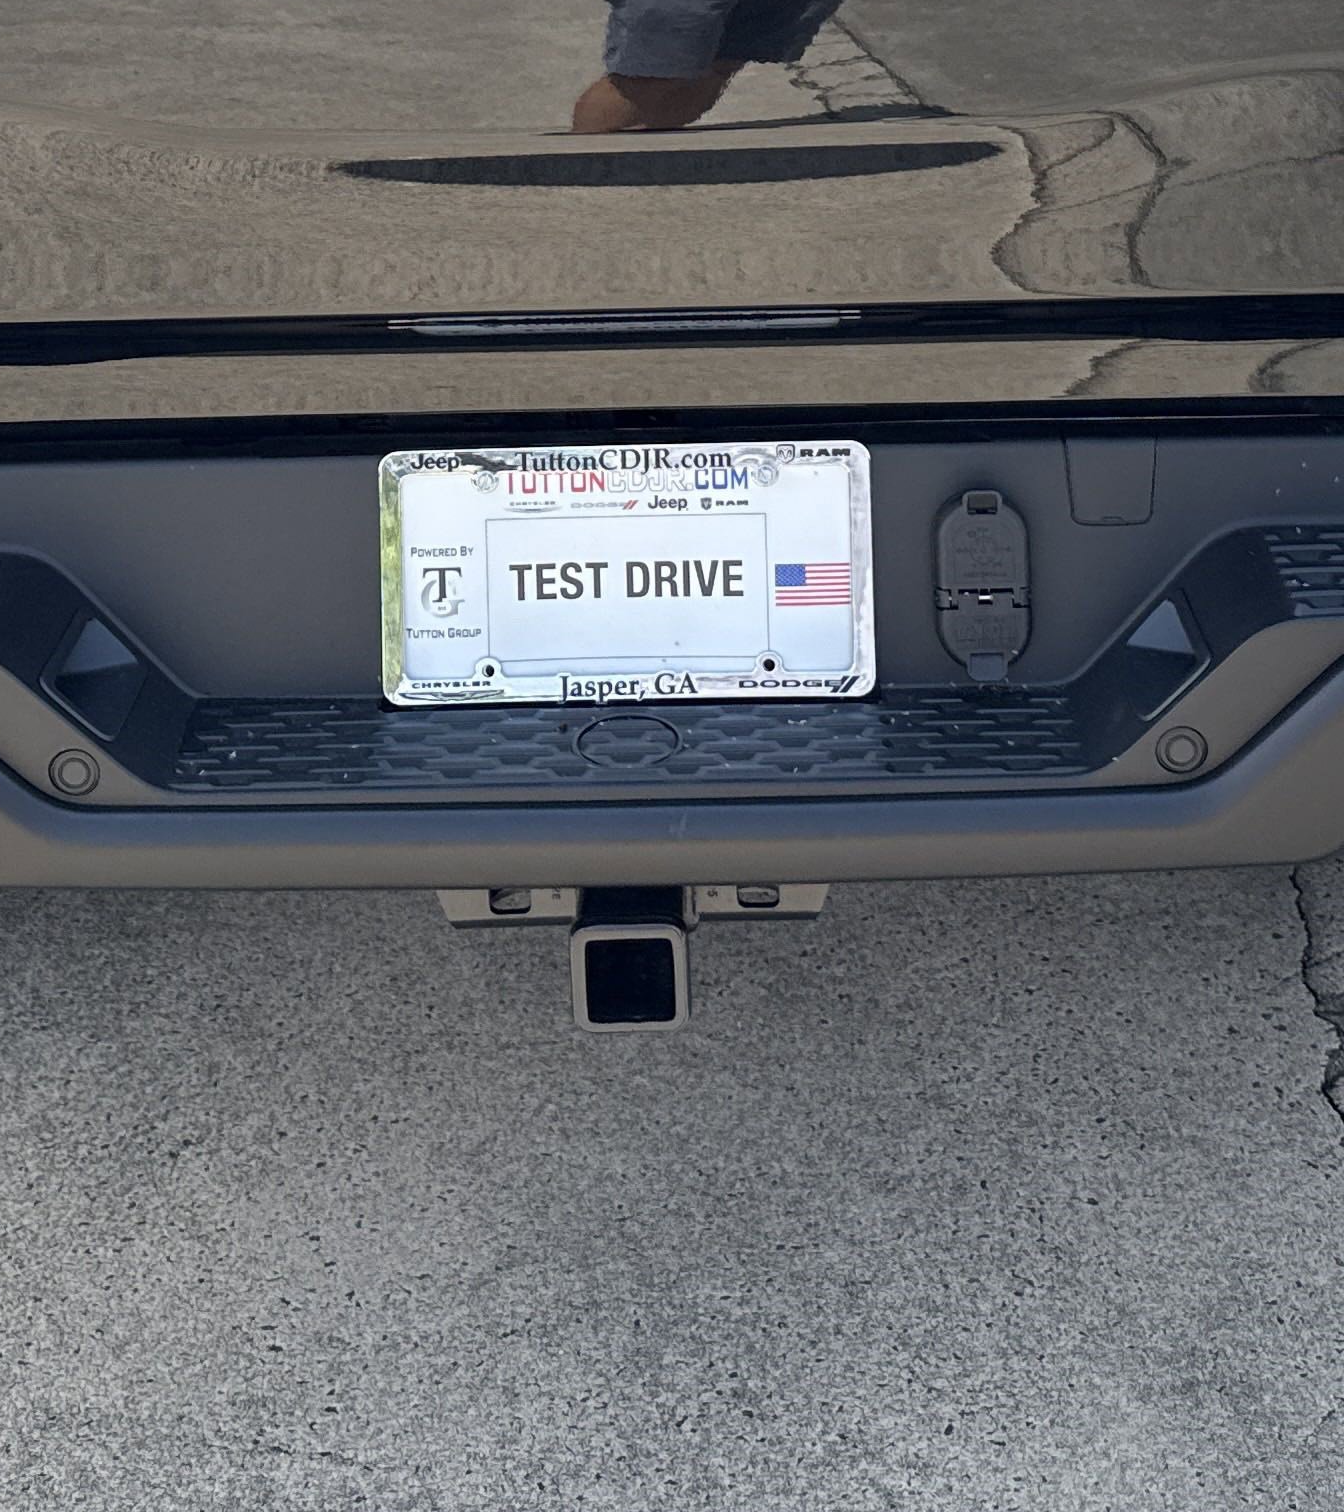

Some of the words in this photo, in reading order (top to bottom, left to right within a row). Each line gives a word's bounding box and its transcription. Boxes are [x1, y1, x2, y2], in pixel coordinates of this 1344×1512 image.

[410, 453, 460, 473] Jeep
[514, 447, 733, 475] TuttonCDJR.com
[799, 448, 851, 458] RAM
[647, 495, 688, 512] Jeep
[715, 498, 749, 507] RAM
[508, 561, 609, 601] TEST
[625, 559, 745, 598] DRIVE
[411, 680, 492, 690] CHRYSLER
[559, 674, 646, 704] Jasper,
[653, 672, 699, 696] GA
[738, 679, 843, 690] DODGE
